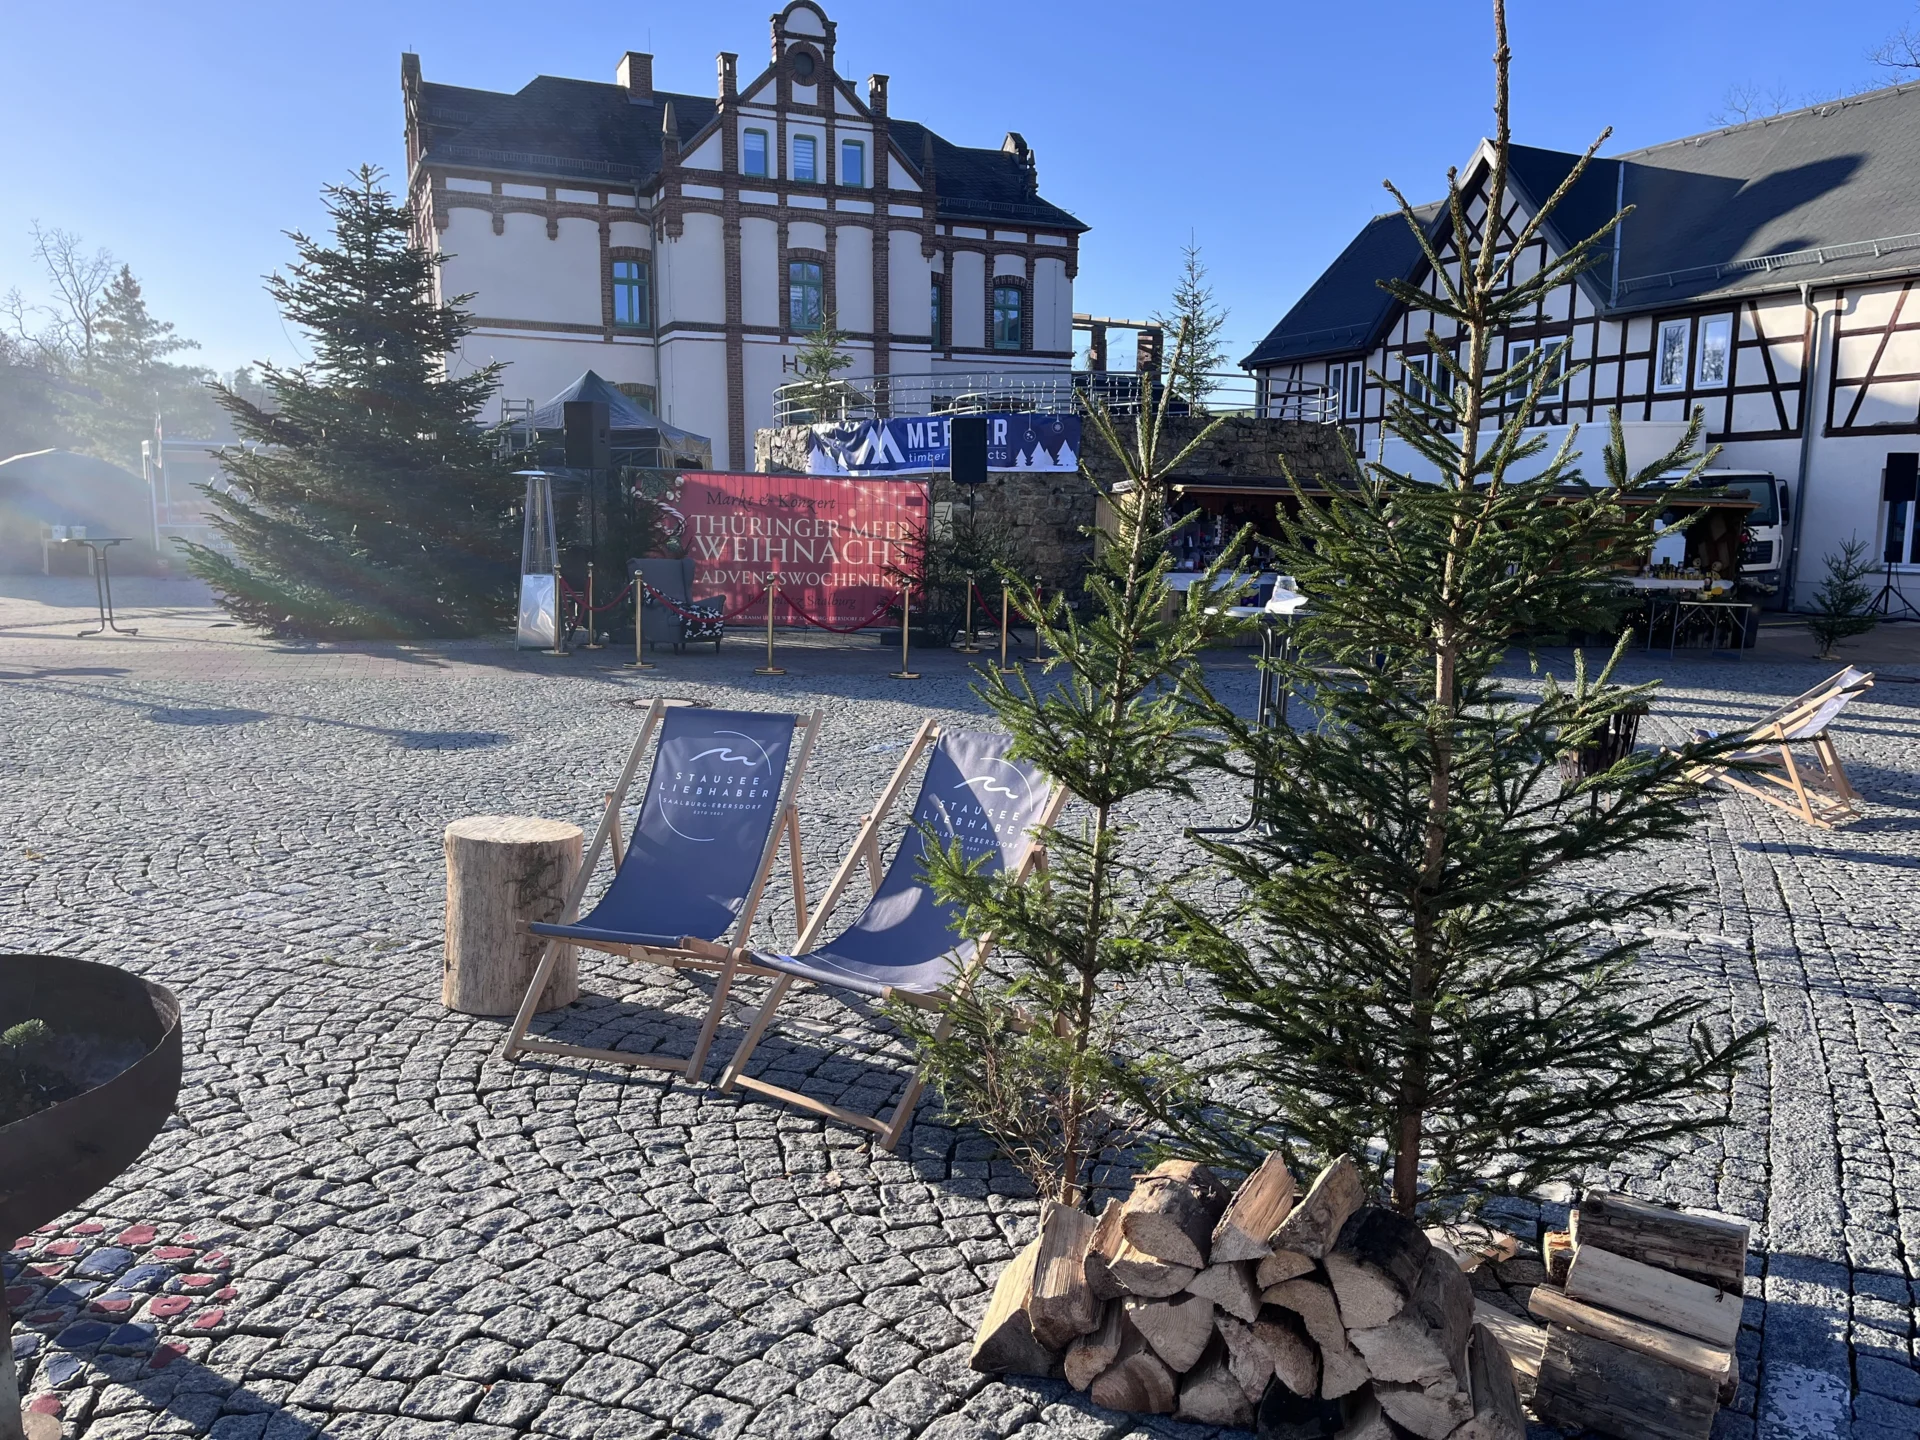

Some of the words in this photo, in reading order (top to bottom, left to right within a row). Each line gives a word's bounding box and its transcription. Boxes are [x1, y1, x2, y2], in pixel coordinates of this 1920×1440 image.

[907, 419, 1008, 449] MERR
[909, 451, 946, 463] timber
[706, 488, 754, 512] Markt
[759, 493, 773, 507] &
[778, 494, 837, 514] Konzert
[691, 511, 842, 539] THÜRINGER
[695, 535, 913, 566] WEIHNACHT
[807, 592, 857, 610] Saalburg
[675, 772, 760, 786] STAUSEE
[659, 782, 769, 798] LIEBHABER
[662, 797, 763, 810] SAALBURG-EBERSDORF
[938, 800, 1020, 821] STAUSEE
[922, 810, 1027, 837] LIEBHABER
